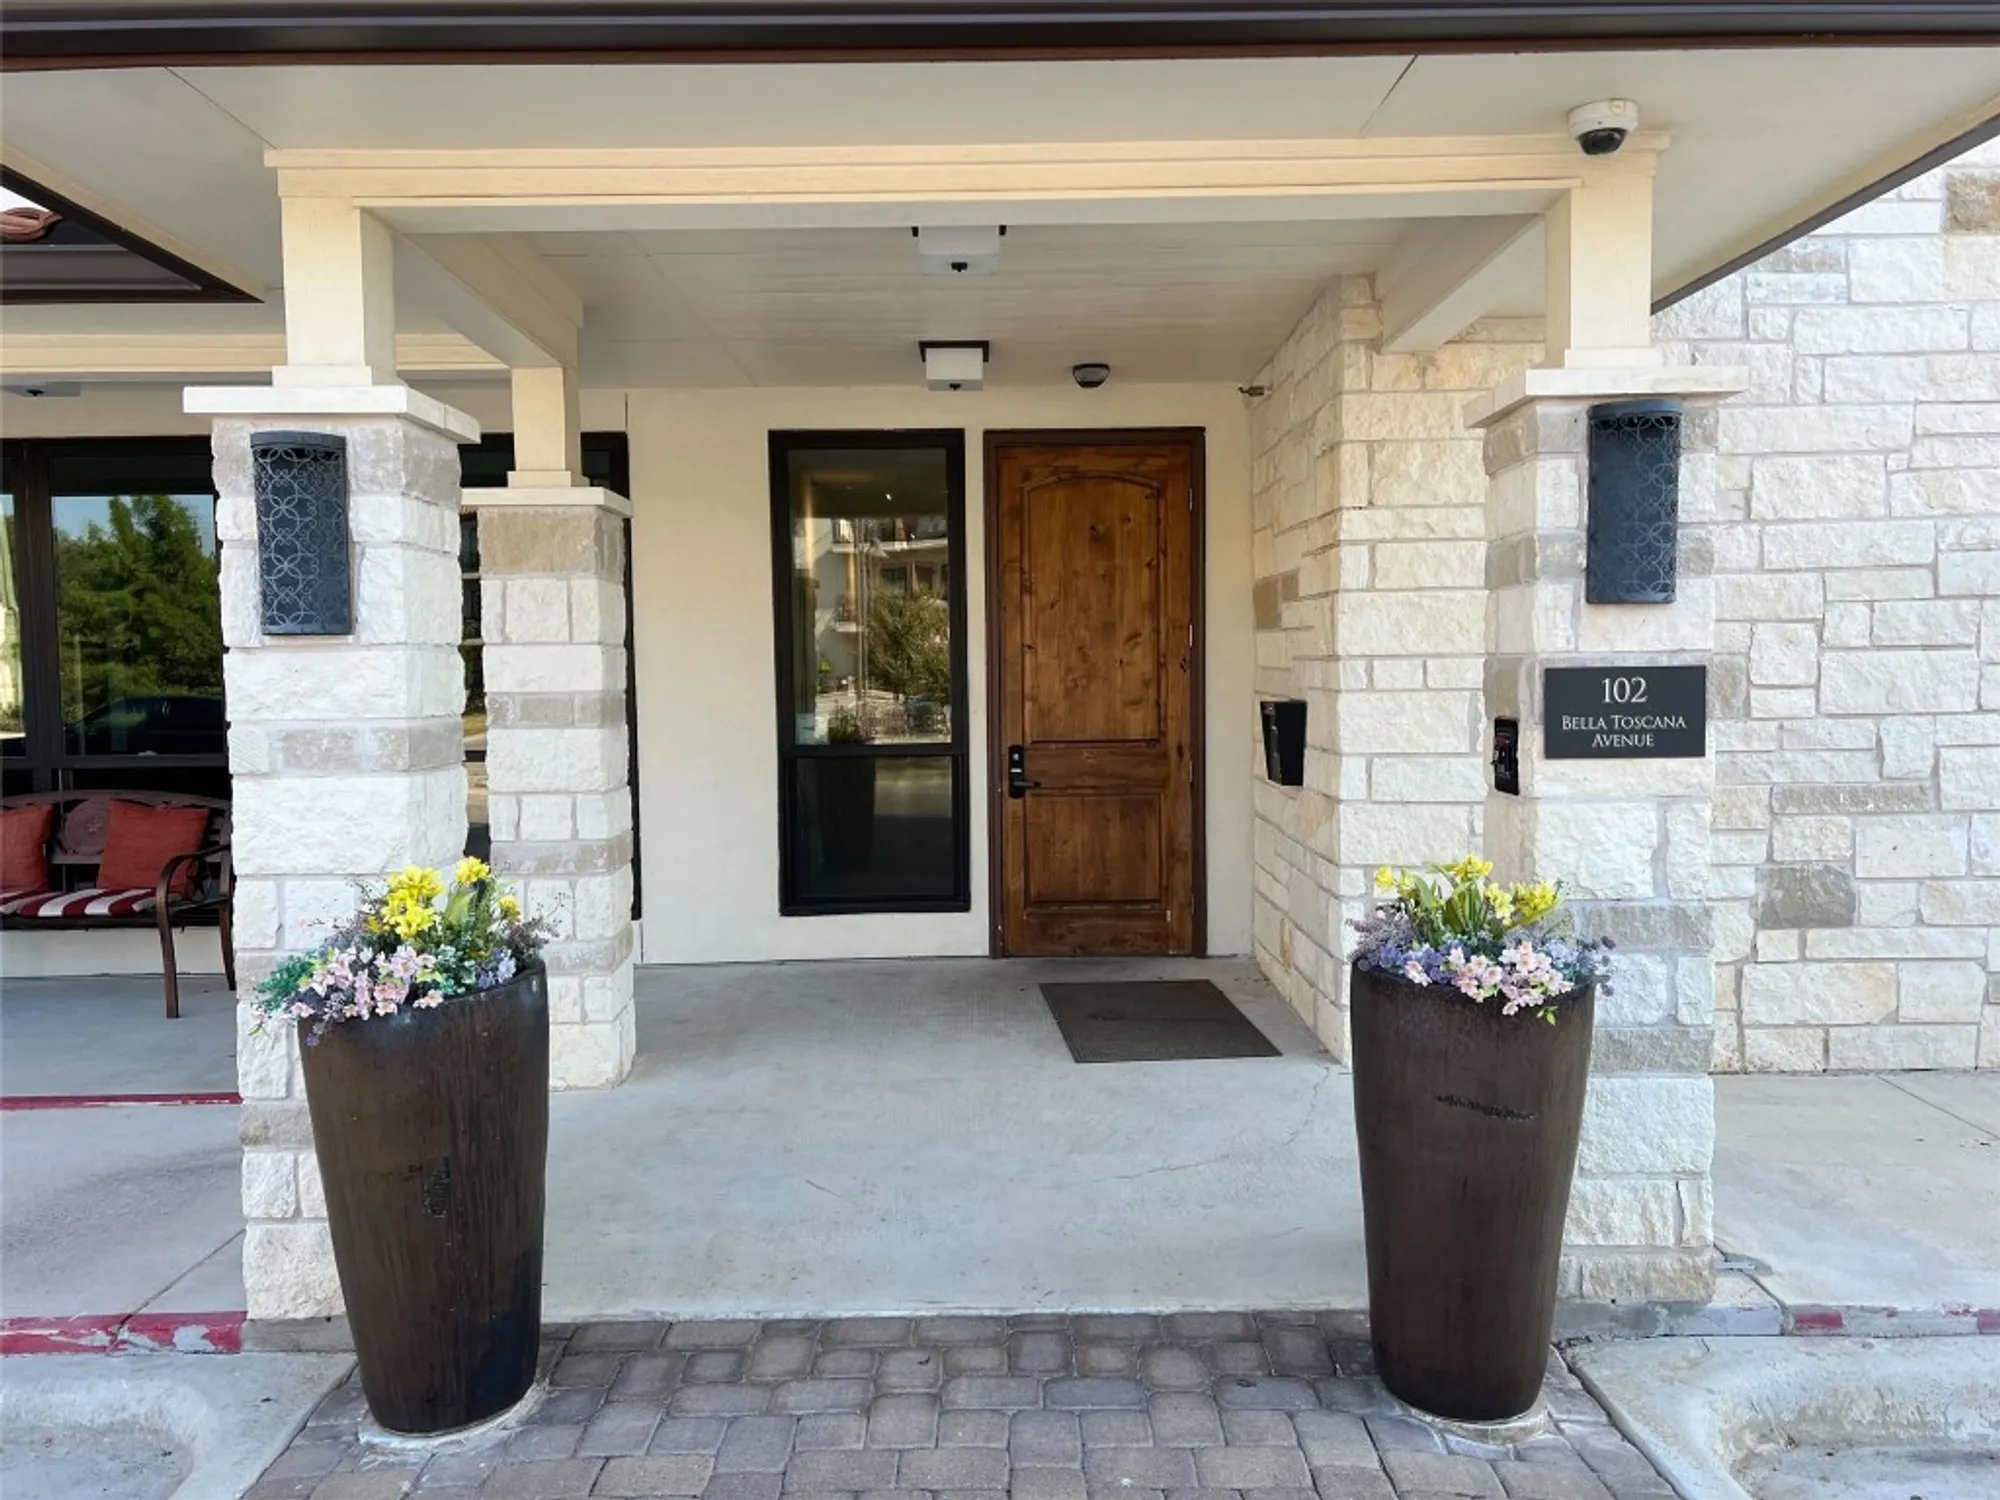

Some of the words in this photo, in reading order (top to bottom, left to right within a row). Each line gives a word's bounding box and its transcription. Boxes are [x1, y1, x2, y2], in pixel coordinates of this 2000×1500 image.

[1602, 676, 1648, 703] 102
[1562, 715, 1607, 730] BELLA
[1610, 714, 1687, 730] TOSCANA
[1591, 733, 1654, 748] AVENUE
